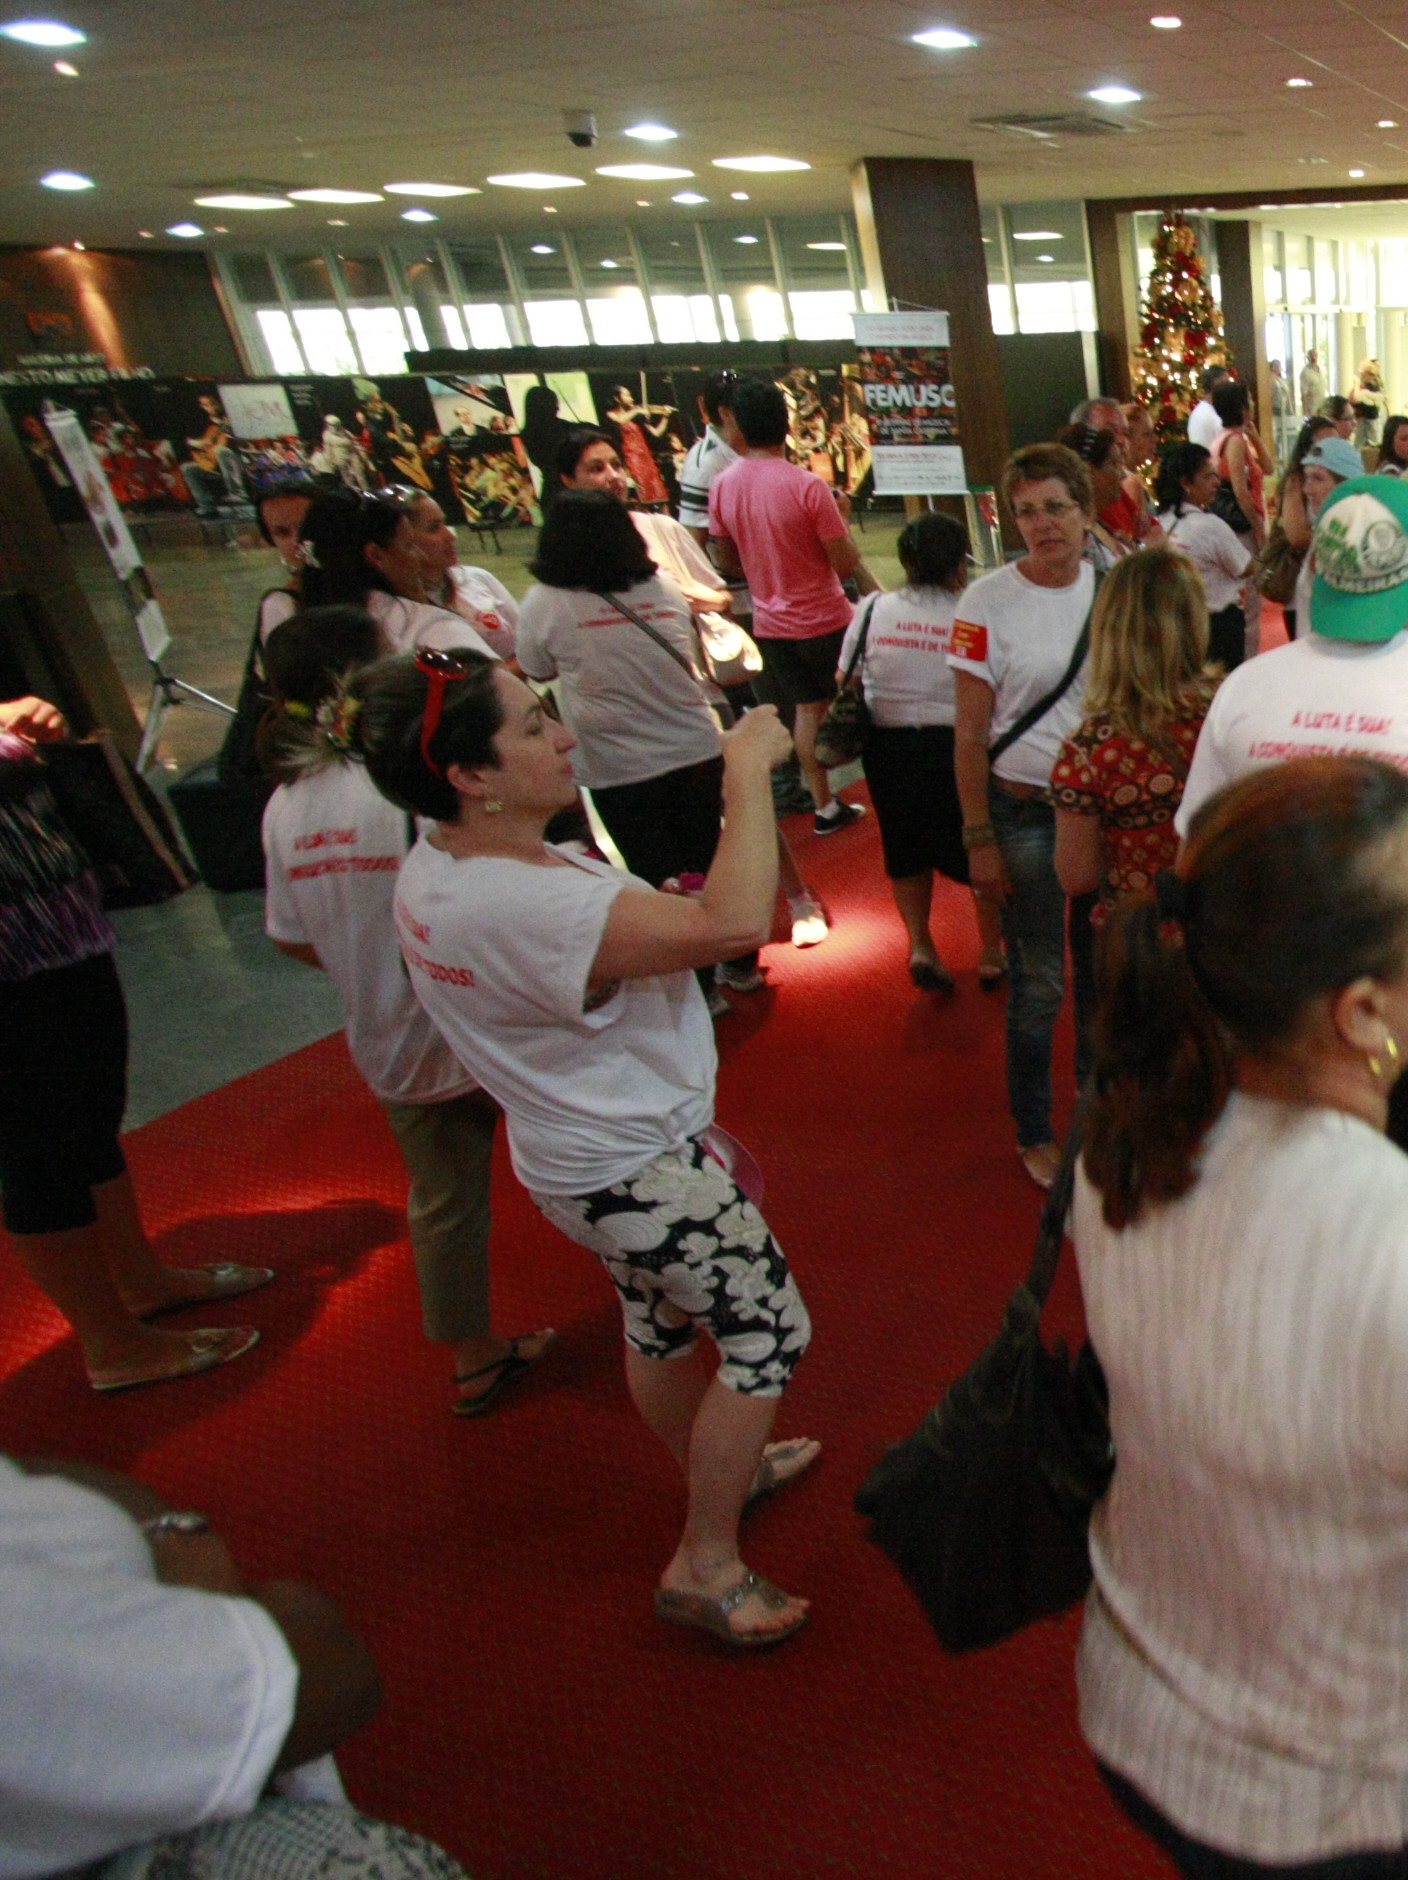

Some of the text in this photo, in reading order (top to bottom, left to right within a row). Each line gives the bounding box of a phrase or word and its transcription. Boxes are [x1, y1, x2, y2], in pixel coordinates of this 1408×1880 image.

[864, 383, 957, 408] FEMUSC
[1292, 710, 1301, 725] A
[1304, 711, 1341, 730] LUTA
